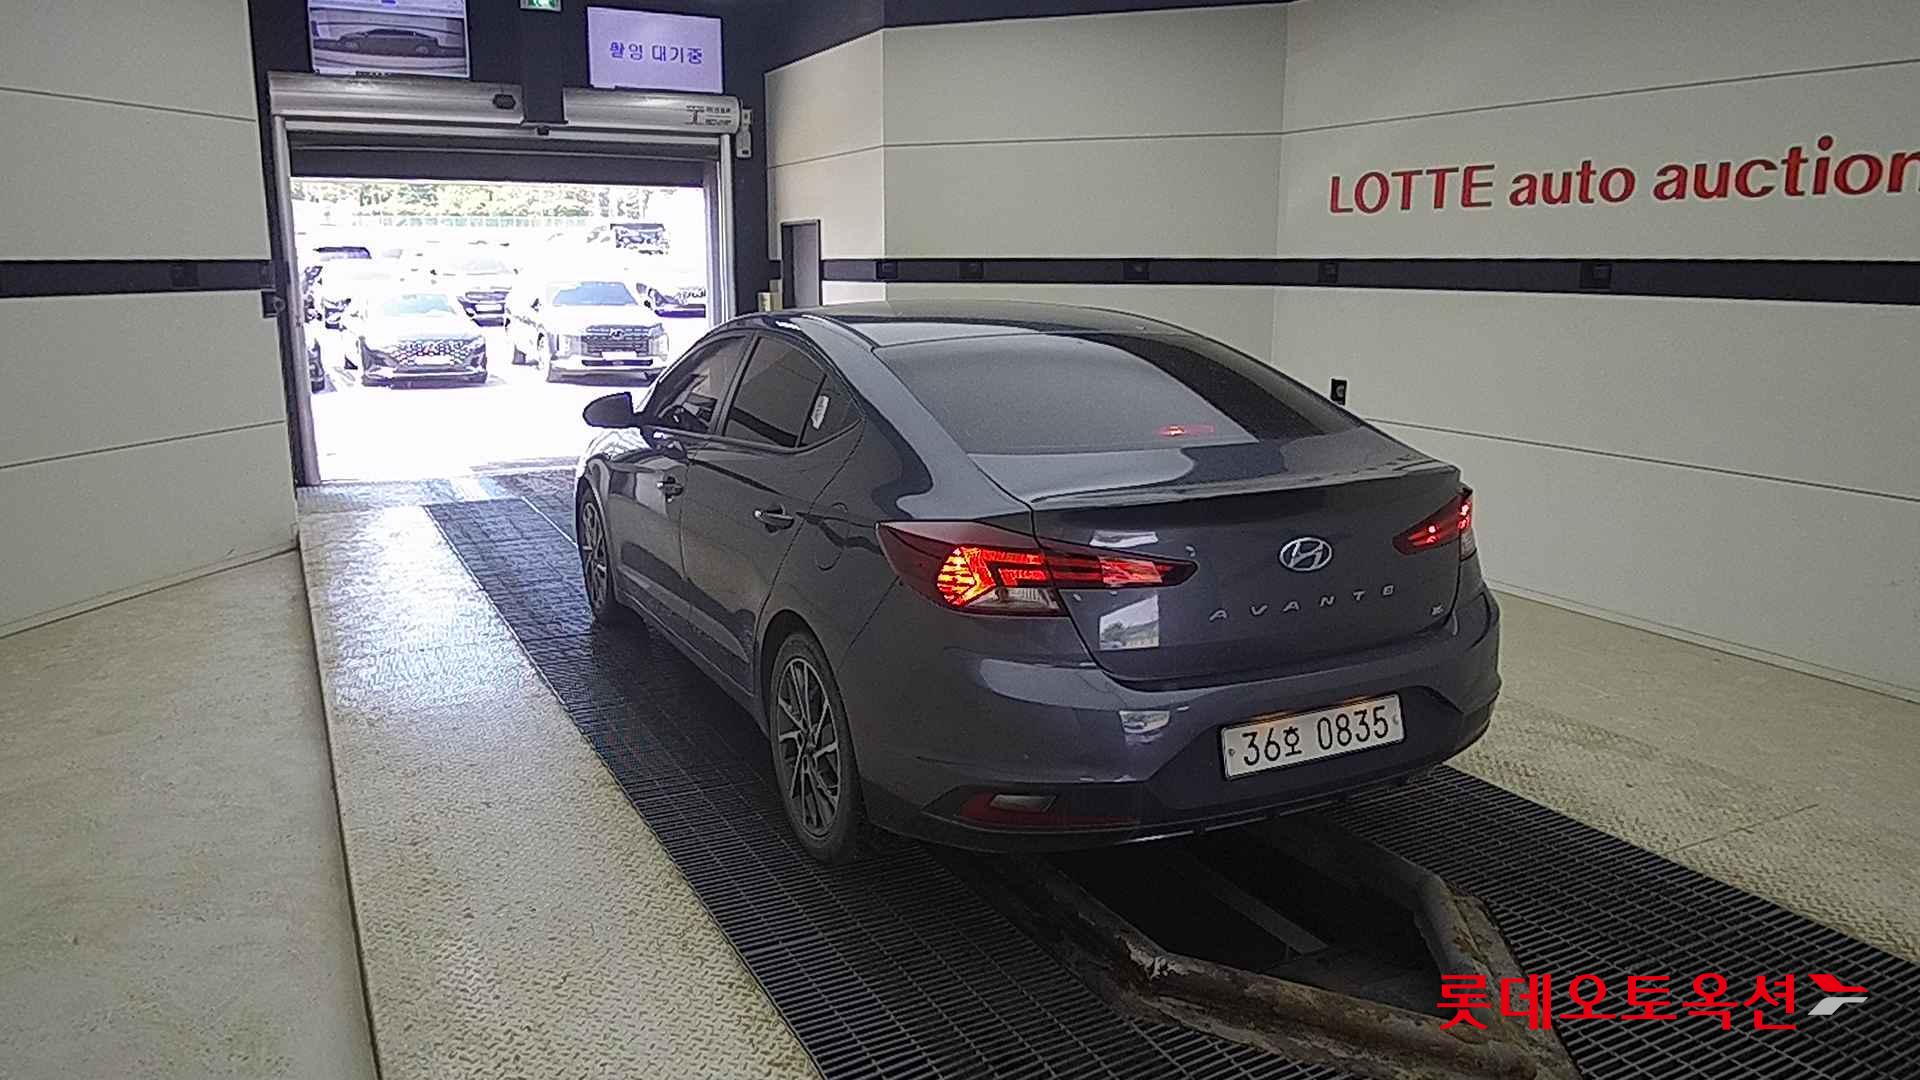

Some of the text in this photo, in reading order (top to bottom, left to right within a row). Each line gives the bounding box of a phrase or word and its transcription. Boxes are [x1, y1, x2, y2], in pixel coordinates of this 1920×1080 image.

[609, 41, 702, 64] 촬영 대기중
[1329, 164, 1495, 214] LOTTE
[1509, 160, 1636, 207] auto
[1209, 584, 1394, 621] AVANTE
[1242, 705, 1389, 766] 36호 0835
